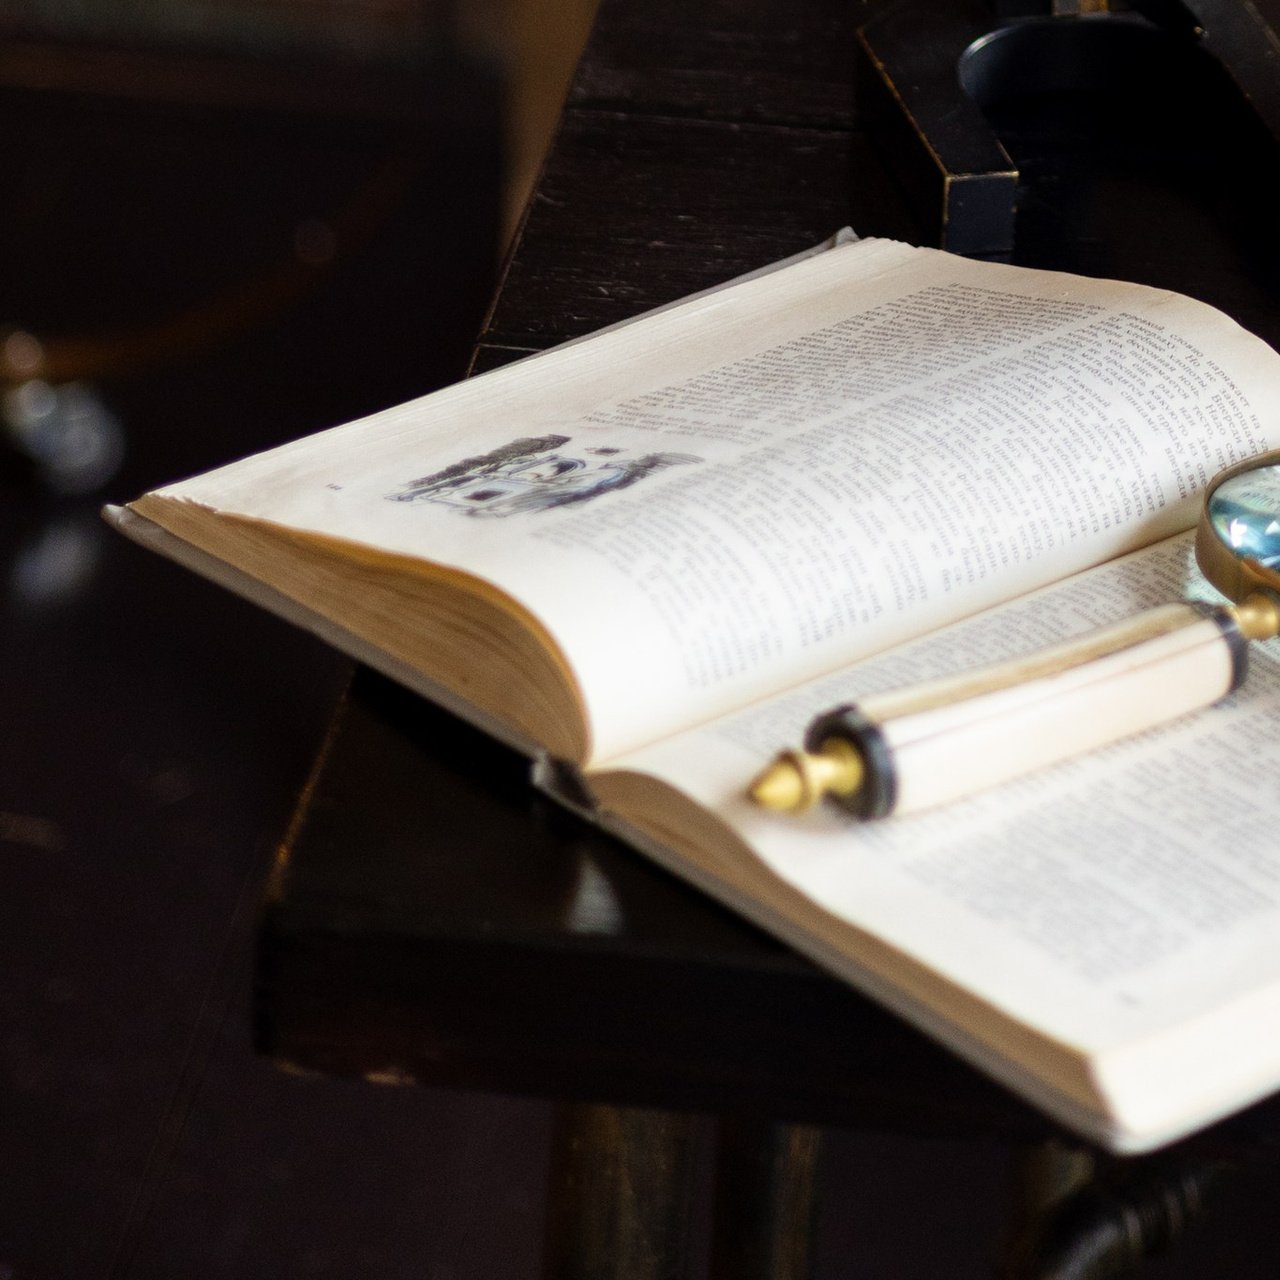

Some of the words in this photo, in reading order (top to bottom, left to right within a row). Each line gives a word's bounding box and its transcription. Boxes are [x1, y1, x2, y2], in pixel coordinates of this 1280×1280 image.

[1109, 349, 1126, 359] его
[1154, 383, 1175, 399] раз
[1178, 406, 1196, 426] или
[1128, 350, 1189, 399] поднимается
[1184, 354, 1200, 367] Но
[1203, 371, 1216, 382] не
[1206, 359, 1250, 407] наряжает
[1249, 413, 1260, 429] на
[1104, 367, 1144, 397] садится
[1144, 400, 1156, 410] за
[1156, 413, 1183, 453] прялку
[1183, 460, 1190, 468] и
[1108, 422, 1126, 444] уже
[1148, 389, 1188, 436] какую-то
[1187, 442, 1198, 456] из
[1205, 403, 1226, 435] Надо
[1210, 394, 1242, 443] Впереди
[1150, 471, 1165, 507] теста
[1164, 447, 1187, 499] впереди
[1079, 489, 1099, 533] лопата
[1102, 512, 1110, 529] на
[1130, 481, 1143, 516] Мать
